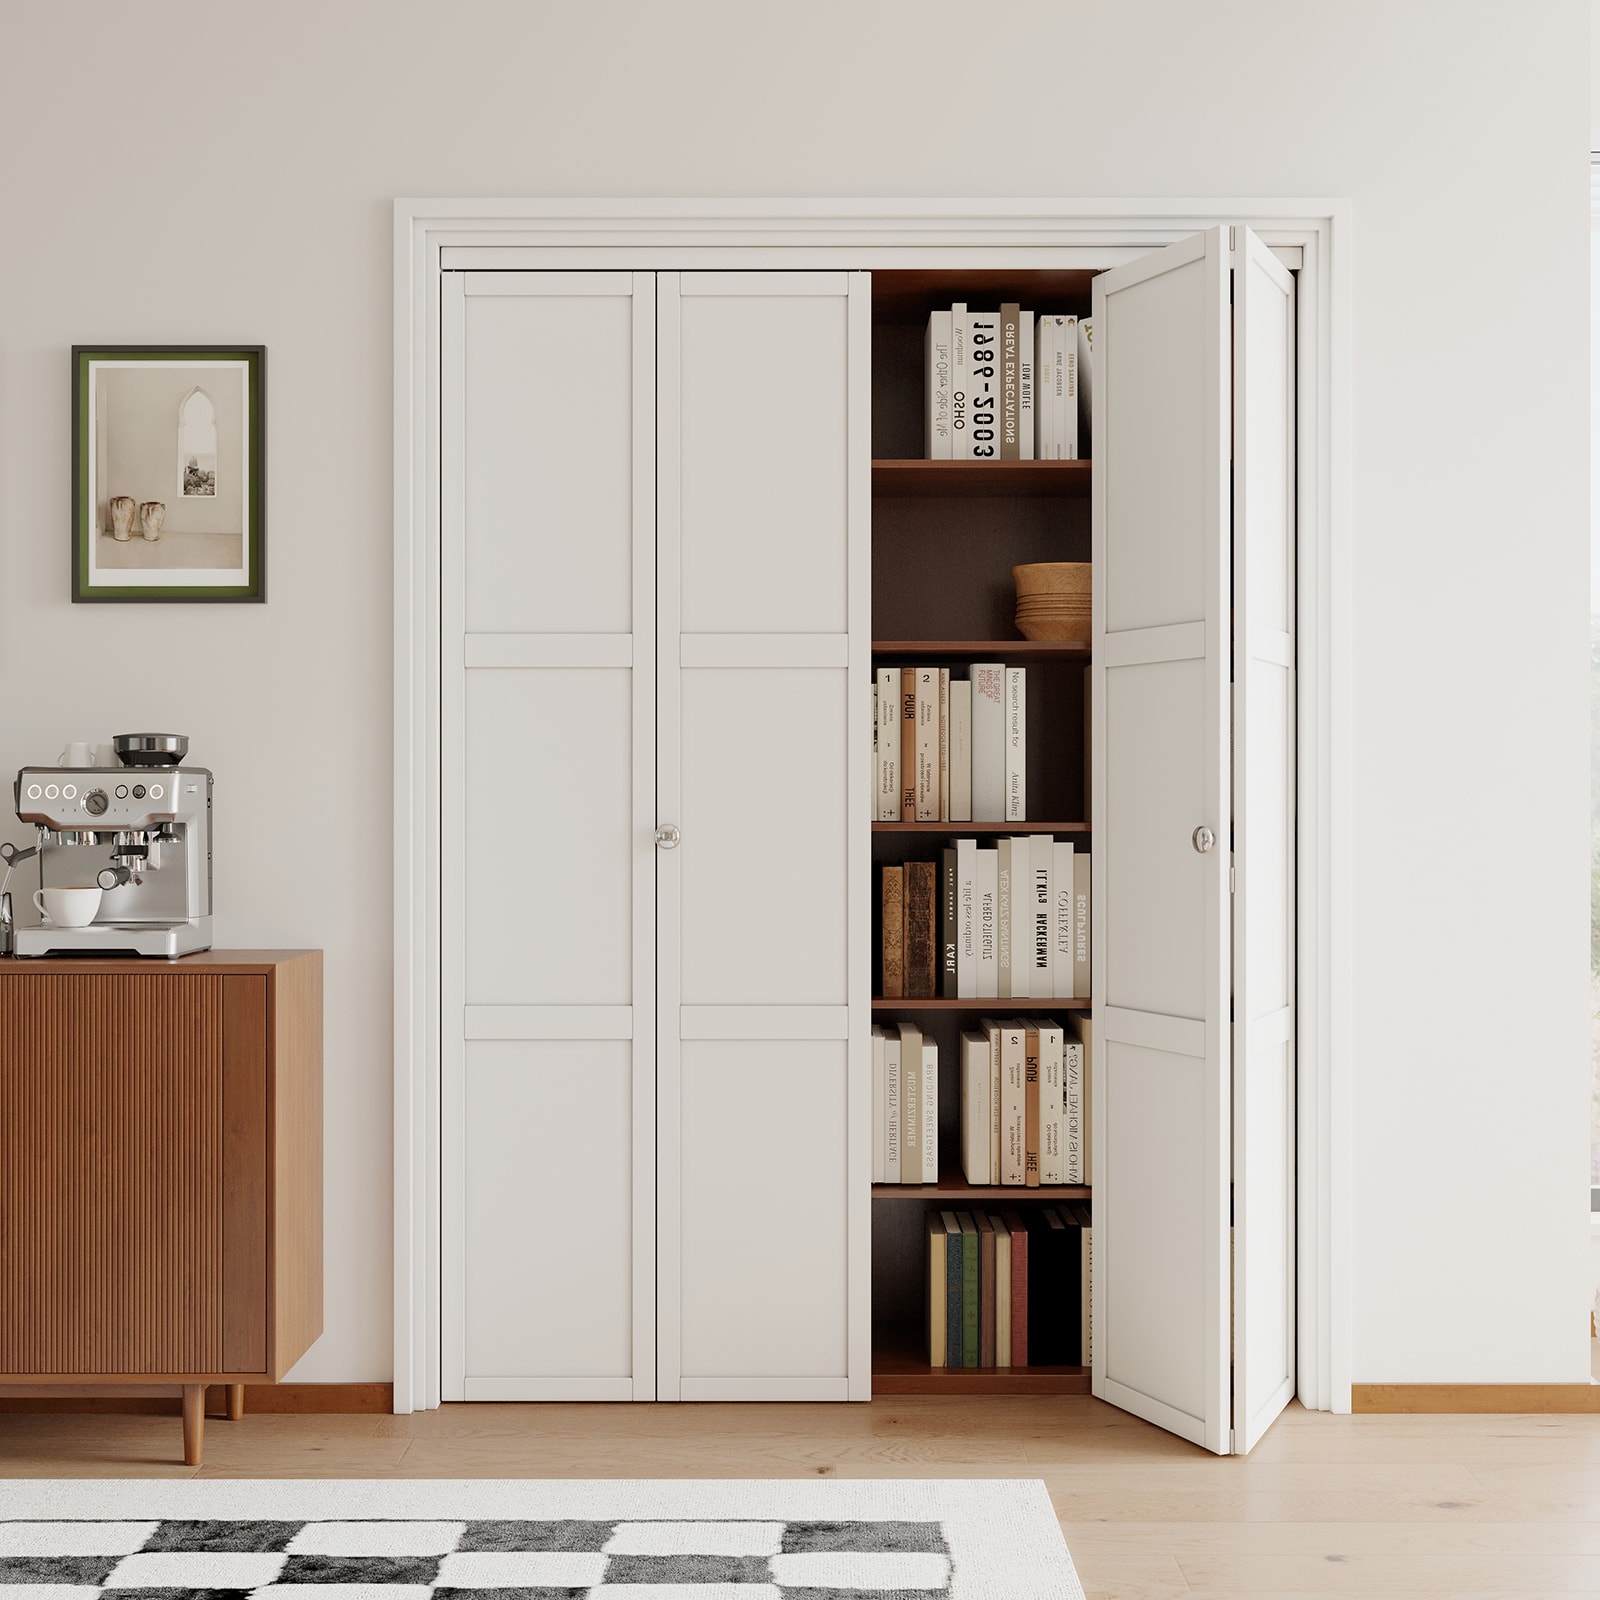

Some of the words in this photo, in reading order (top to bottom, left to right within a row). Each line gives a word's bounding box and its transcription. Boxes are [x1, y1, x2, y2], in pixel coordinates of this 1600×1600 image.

[885, 674, 890, 682] 1
[923, 675, 930, 683] 2
[1012, 672, 1019, 682] No
[986, 691, 992, 699] OF
[1012, 685, 1020, 711] search
[905, 694, 915, 719] PUUR
[1012, 713, 1020, 734] result
[1012, 737, 1020, 747] for
[1011, 772, 1019, 793] Anita
[905, 788, 915, 807] THEE
[1011, 796, 1019, 816] Klinz
